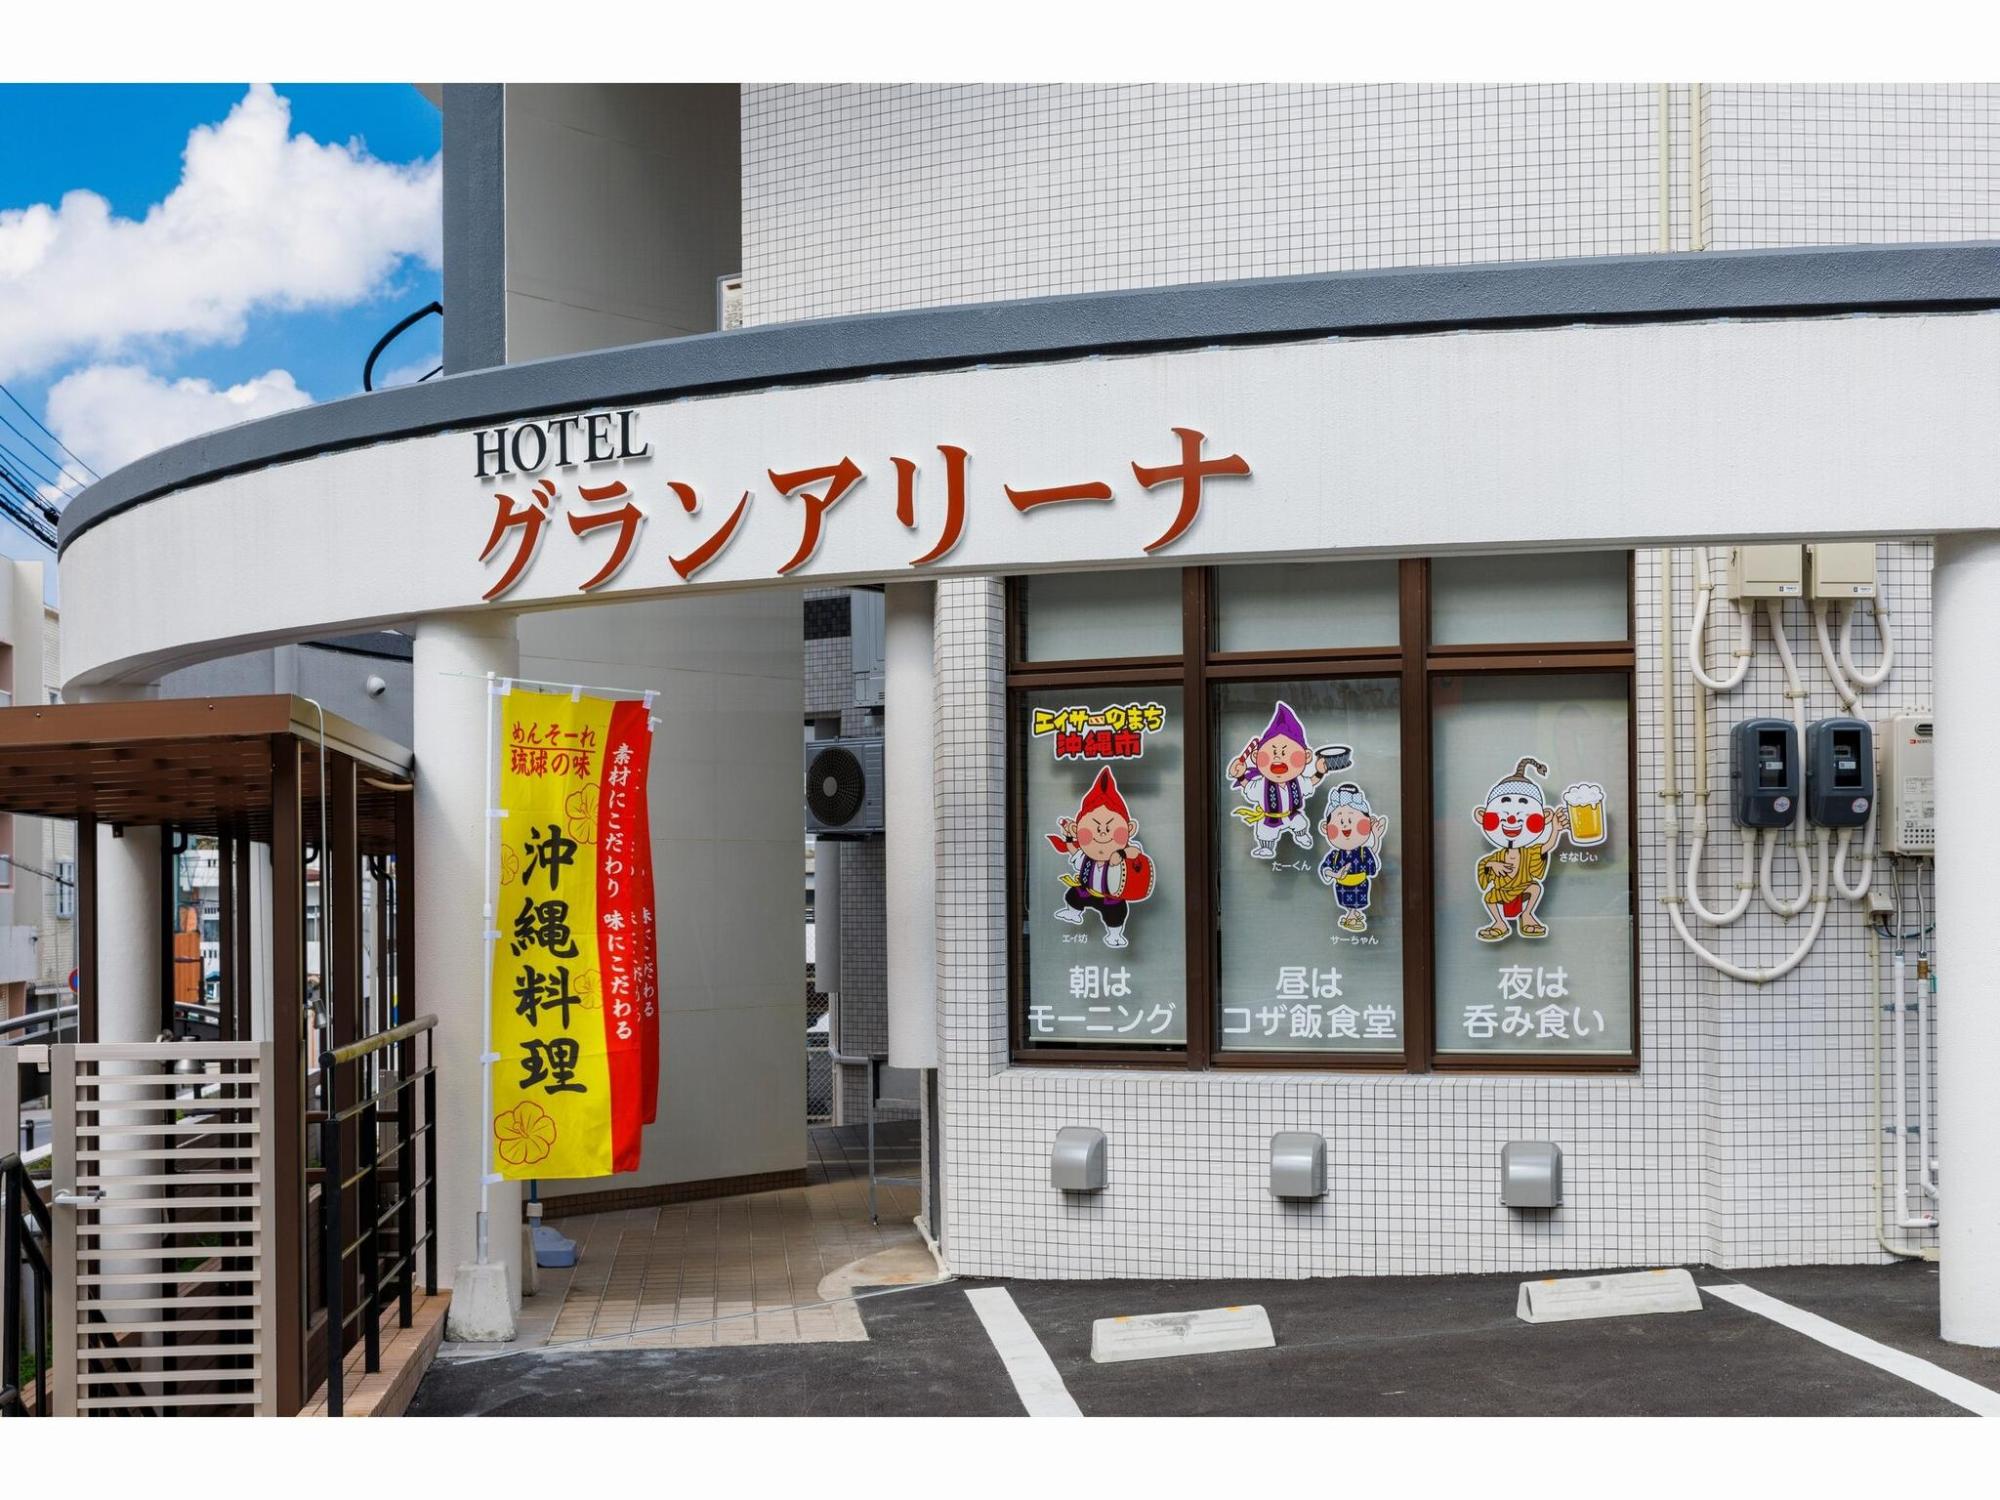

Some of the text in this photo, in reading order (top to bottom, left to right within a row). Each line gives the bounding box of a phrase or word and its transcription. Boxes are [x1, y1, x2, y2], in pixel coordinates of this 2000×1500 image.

[474, 410, 649, 478] HOTEL
[479, 427, 1251, 601] グランアリーナ
[511, 720, 596, 748] めんそーれ
[1033, 703, 1164, 735] エイサーのまち
[1056, 730, 1142, 758] 沖縄市
[511, 749, 591, 780] 琉球の味
[1271, 860, 1312, 872] たーくん
[603, 742, 634, 1040] 素材にこだわり 味にこだわる
[1062, 933, 1088, 945] エイ坊
[1330, 934, 1379, 946] サーちゃん
[510, 824, 588, 1095] 沖縄料理
[1069, 965, 1132, 999] 朝は
[1276, 966, 1343, 1000] 昼は
[1498, 964, 1568, 1000] 夜は
[1028, 1002, 1176, 1034] モーニング
[1223, 1003, 1397, 1039] コザ飯食堂
[1463, 1003, 1604, 1039] 呑み食い
